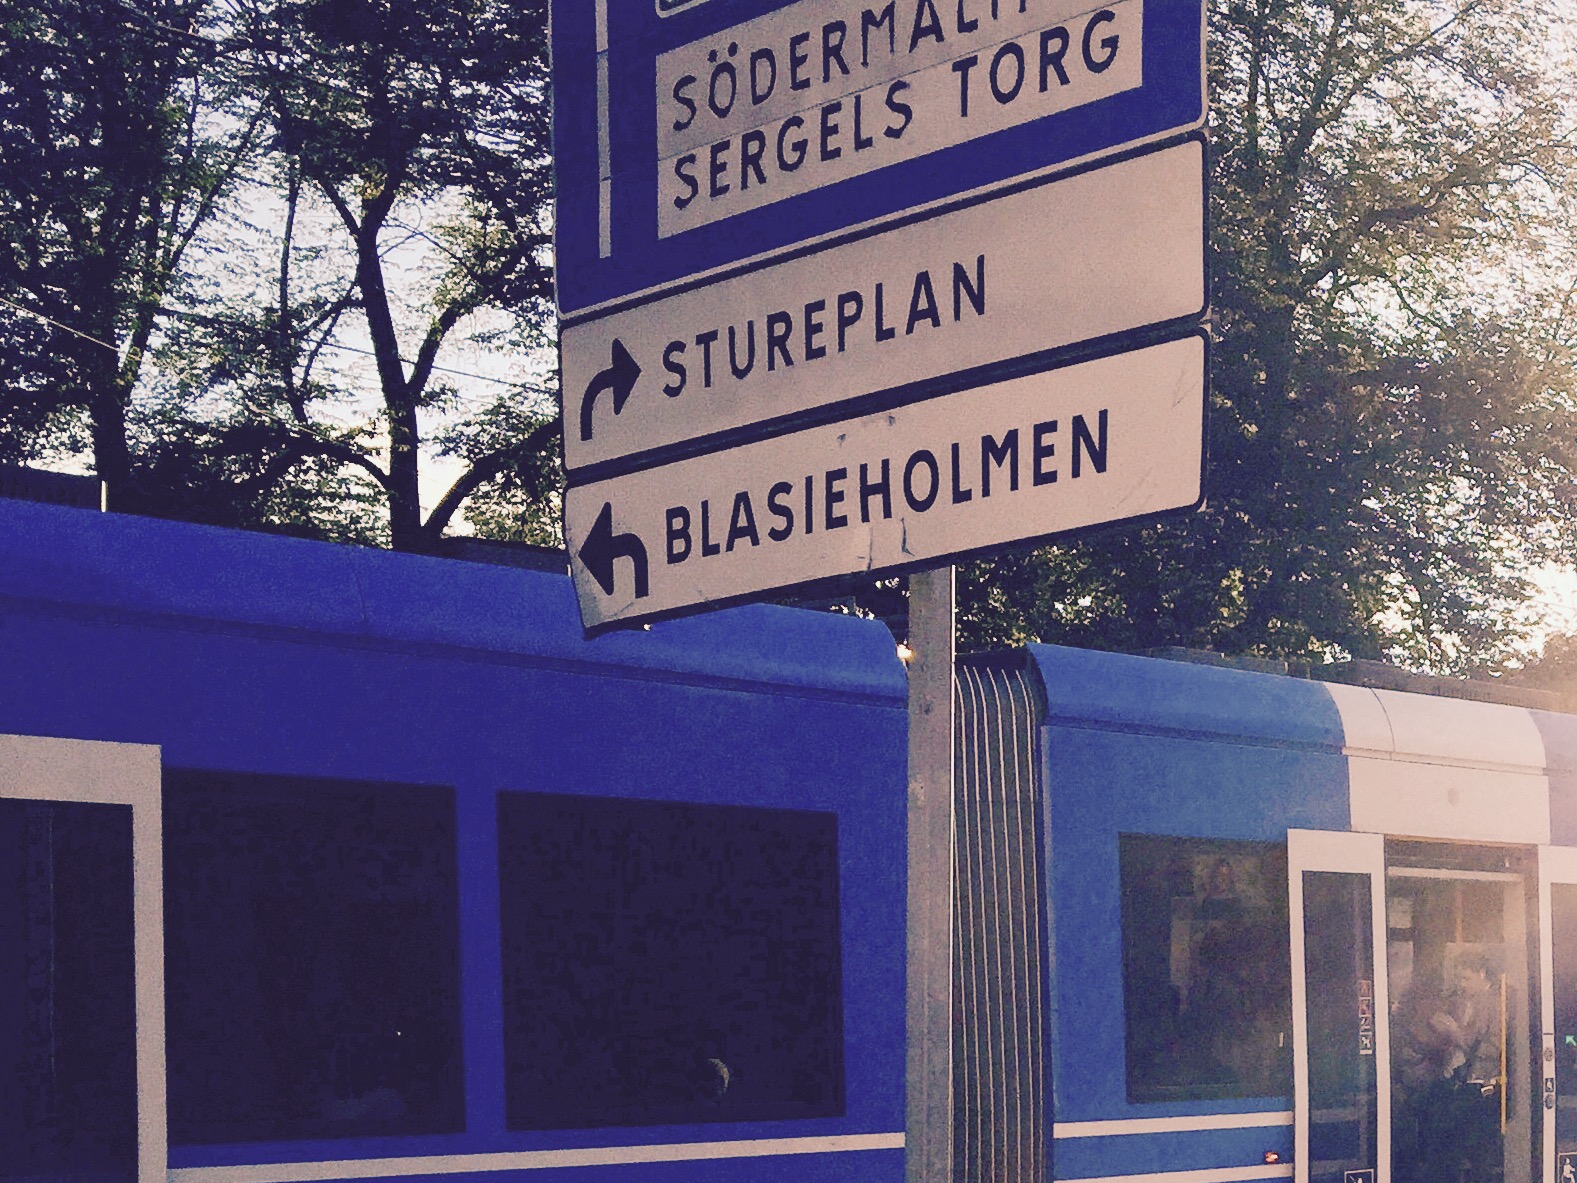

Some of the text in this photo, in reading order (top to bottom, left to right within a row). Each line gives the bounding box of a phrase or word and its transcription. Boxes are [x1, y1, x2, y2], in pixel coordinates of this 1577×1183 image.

[673, 9, 1120, 213] SERGELS TORG
[661, 254, 986, 399] STUREPLAN
[665, 408, 1109, 565] BLASIEHOLMEN
